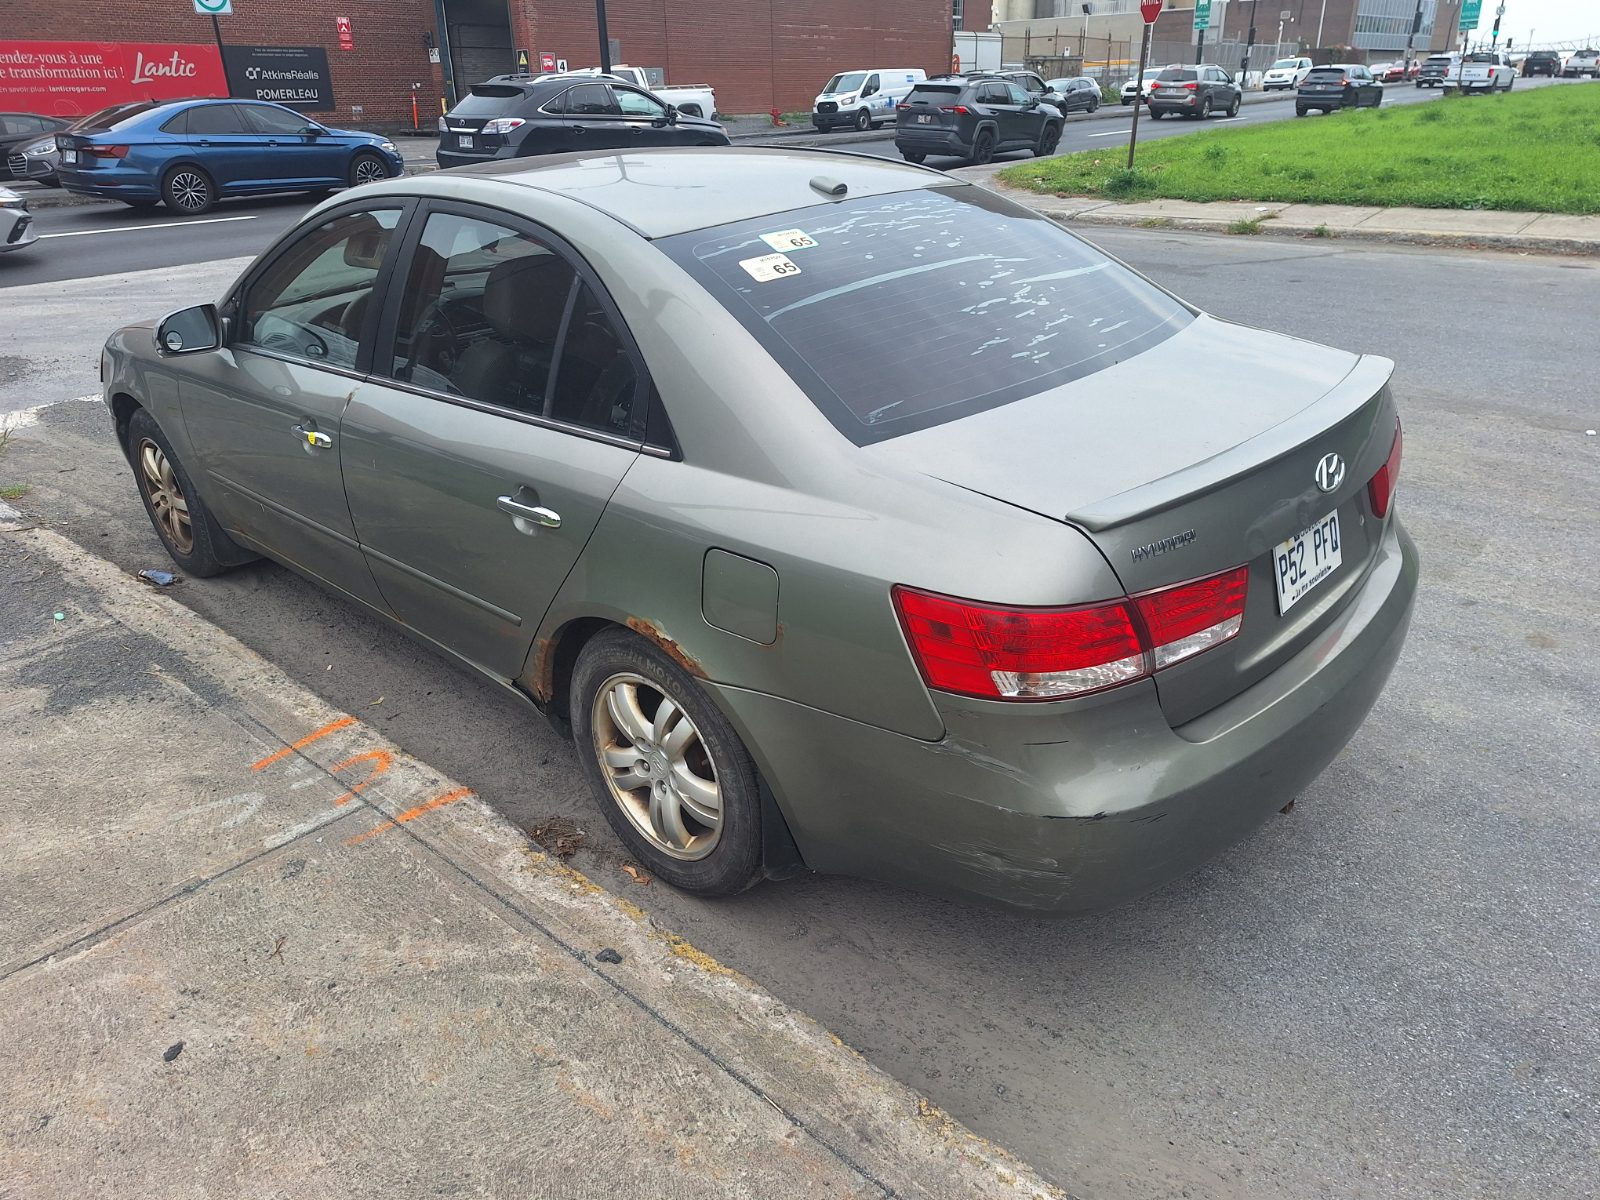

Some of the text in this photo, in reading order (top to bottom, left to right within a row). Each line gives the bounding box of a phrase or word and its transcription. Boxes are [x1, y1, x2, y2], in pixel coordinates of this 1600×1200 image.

[69, 50, 77, 64] à
[80, 54, 103, 64] une
[9, 64, 101, 79] transformation
[103, 66, 118, 79] ici
[131, 50, 197, 84] Lantic
[559, 61, 566, 71] 4
[261, 70, 319, 80] AtkinsRéalis
[256, 89, 318, 99] POMERLEAU
[790, 237, 813, 247] 65
[773, 262, 797, 274] 65
[1278, 516, 1339, 594] P52 PFQ
